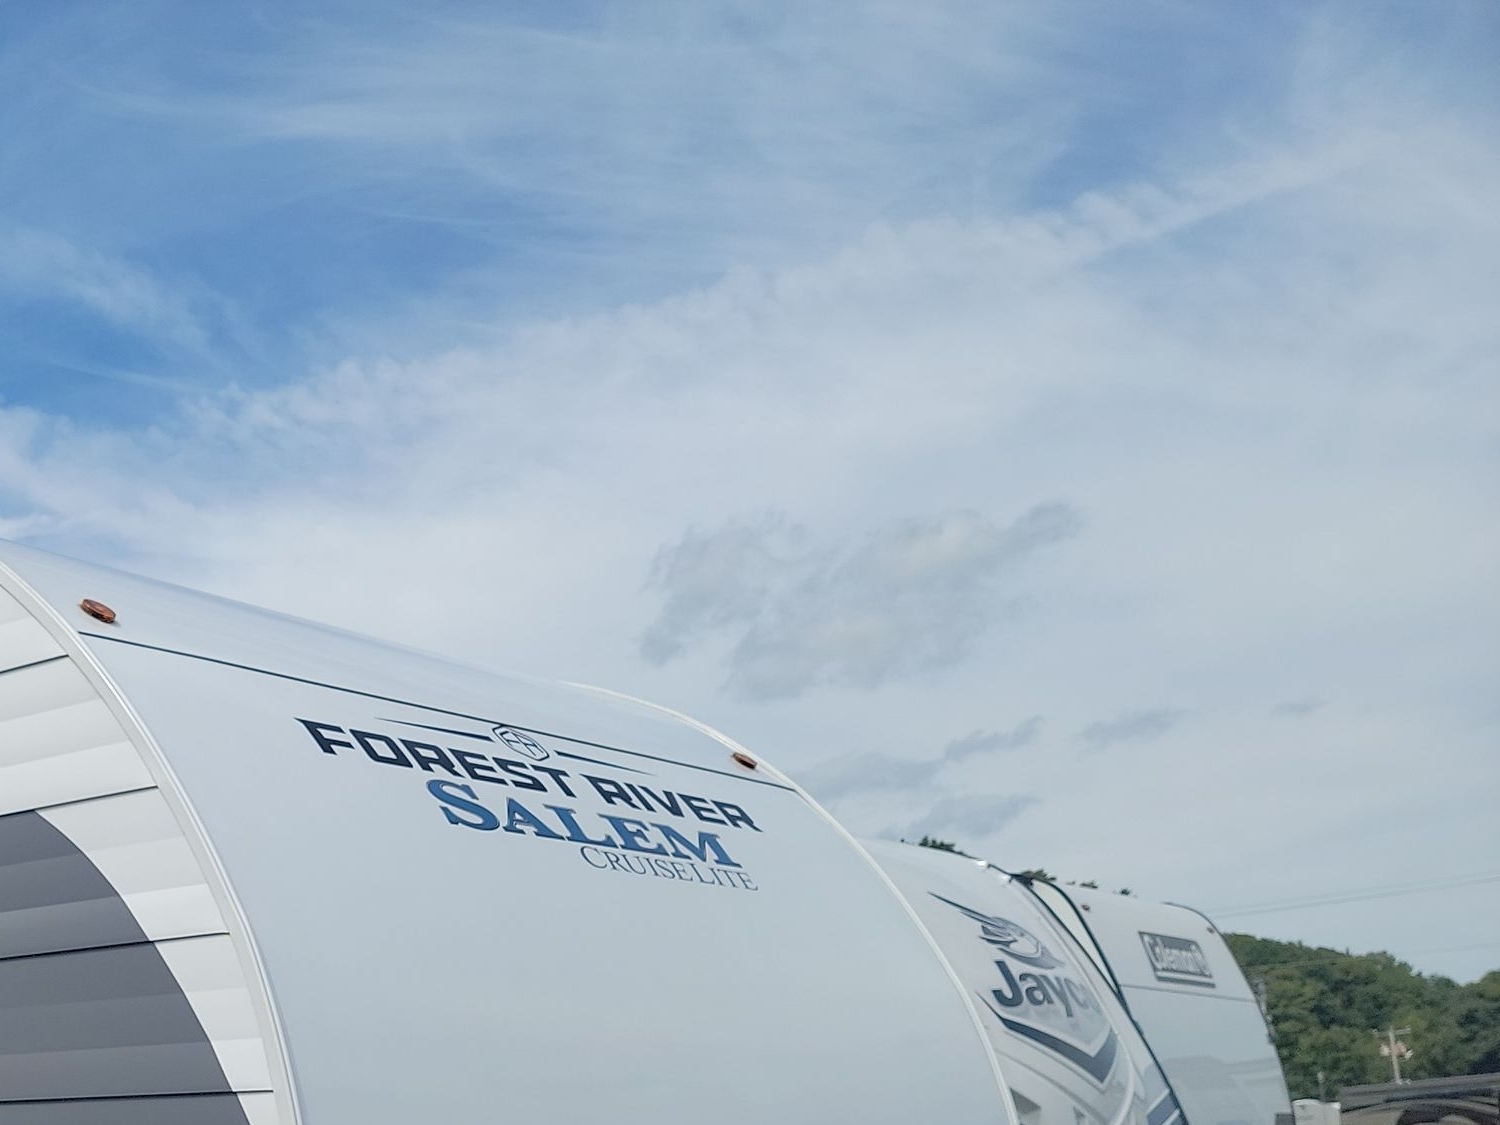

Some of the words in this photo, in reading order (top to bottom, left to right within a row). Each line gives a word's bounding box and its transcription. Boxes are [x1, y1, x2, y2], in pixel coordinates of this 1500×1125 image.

[293, 717, 577, 798] FOREST
[579, 773, 764, 833] RIVER
[426, 779, 743, 868] SALEM
[991, 960, 1104, 1017] Jayc
